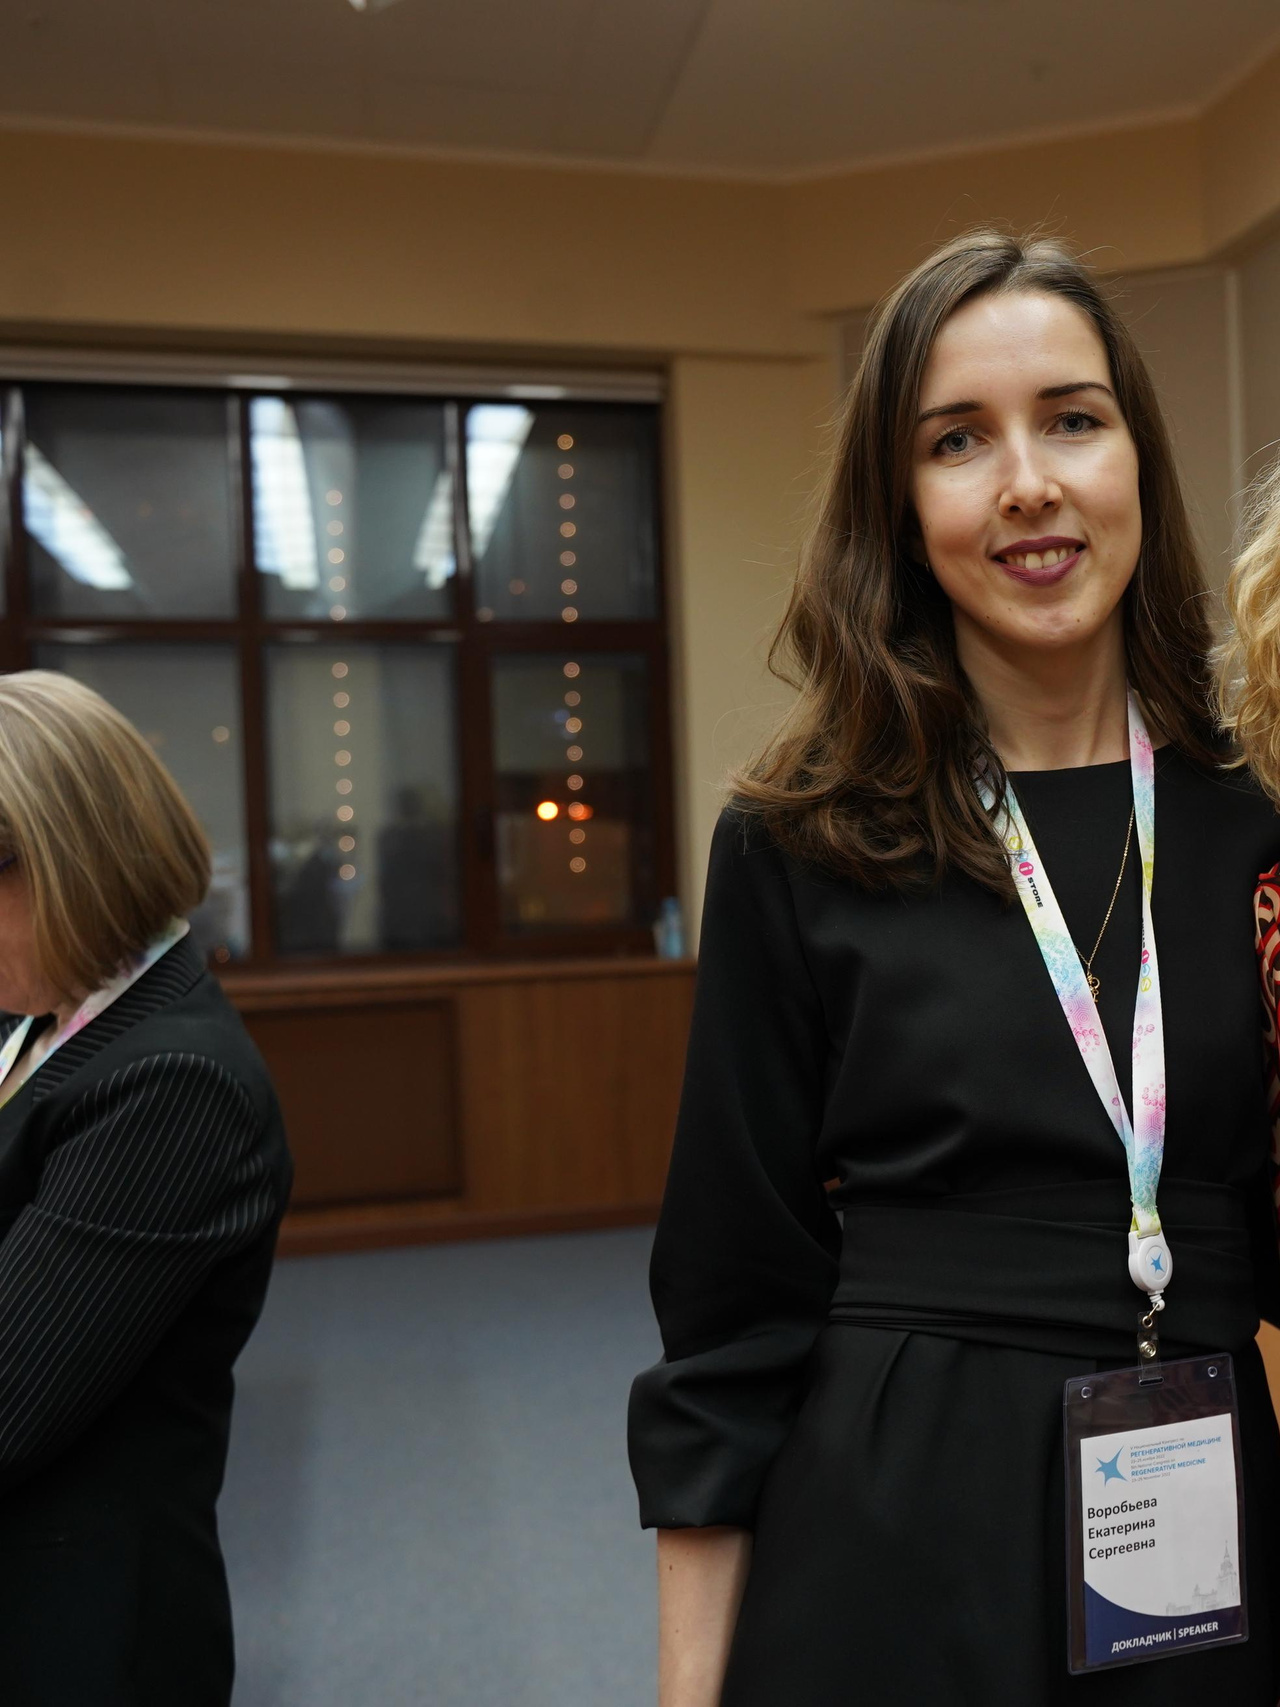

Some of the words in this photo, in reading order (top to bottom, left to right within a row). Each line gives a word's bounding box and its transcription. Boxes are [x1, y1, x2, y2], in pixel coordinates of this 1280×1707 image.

[1028, 877, 1043, 908] STORE
[1130, 1443, 1186, 1458] РЕГЕНЕРАТИВНОЙ
[1187, 1436, 1221, 1448] МЕДИЦИНЕ
[1131, 1463, 1176, 1477] REGENERATIVE
[1177, 1457, 1206, 1468] MEDICINE
[1087, 1498, 1158, 1520] Воробьева
[1088, 1518, 1156, 1540] Екатерина
[1088, 1538, 1156, 1560] Сергеевна
[1111, 1630, 1172, 1653] ДОКЛАДЧИК
[1178, 1621, 1219, 1638] SPEAKER
